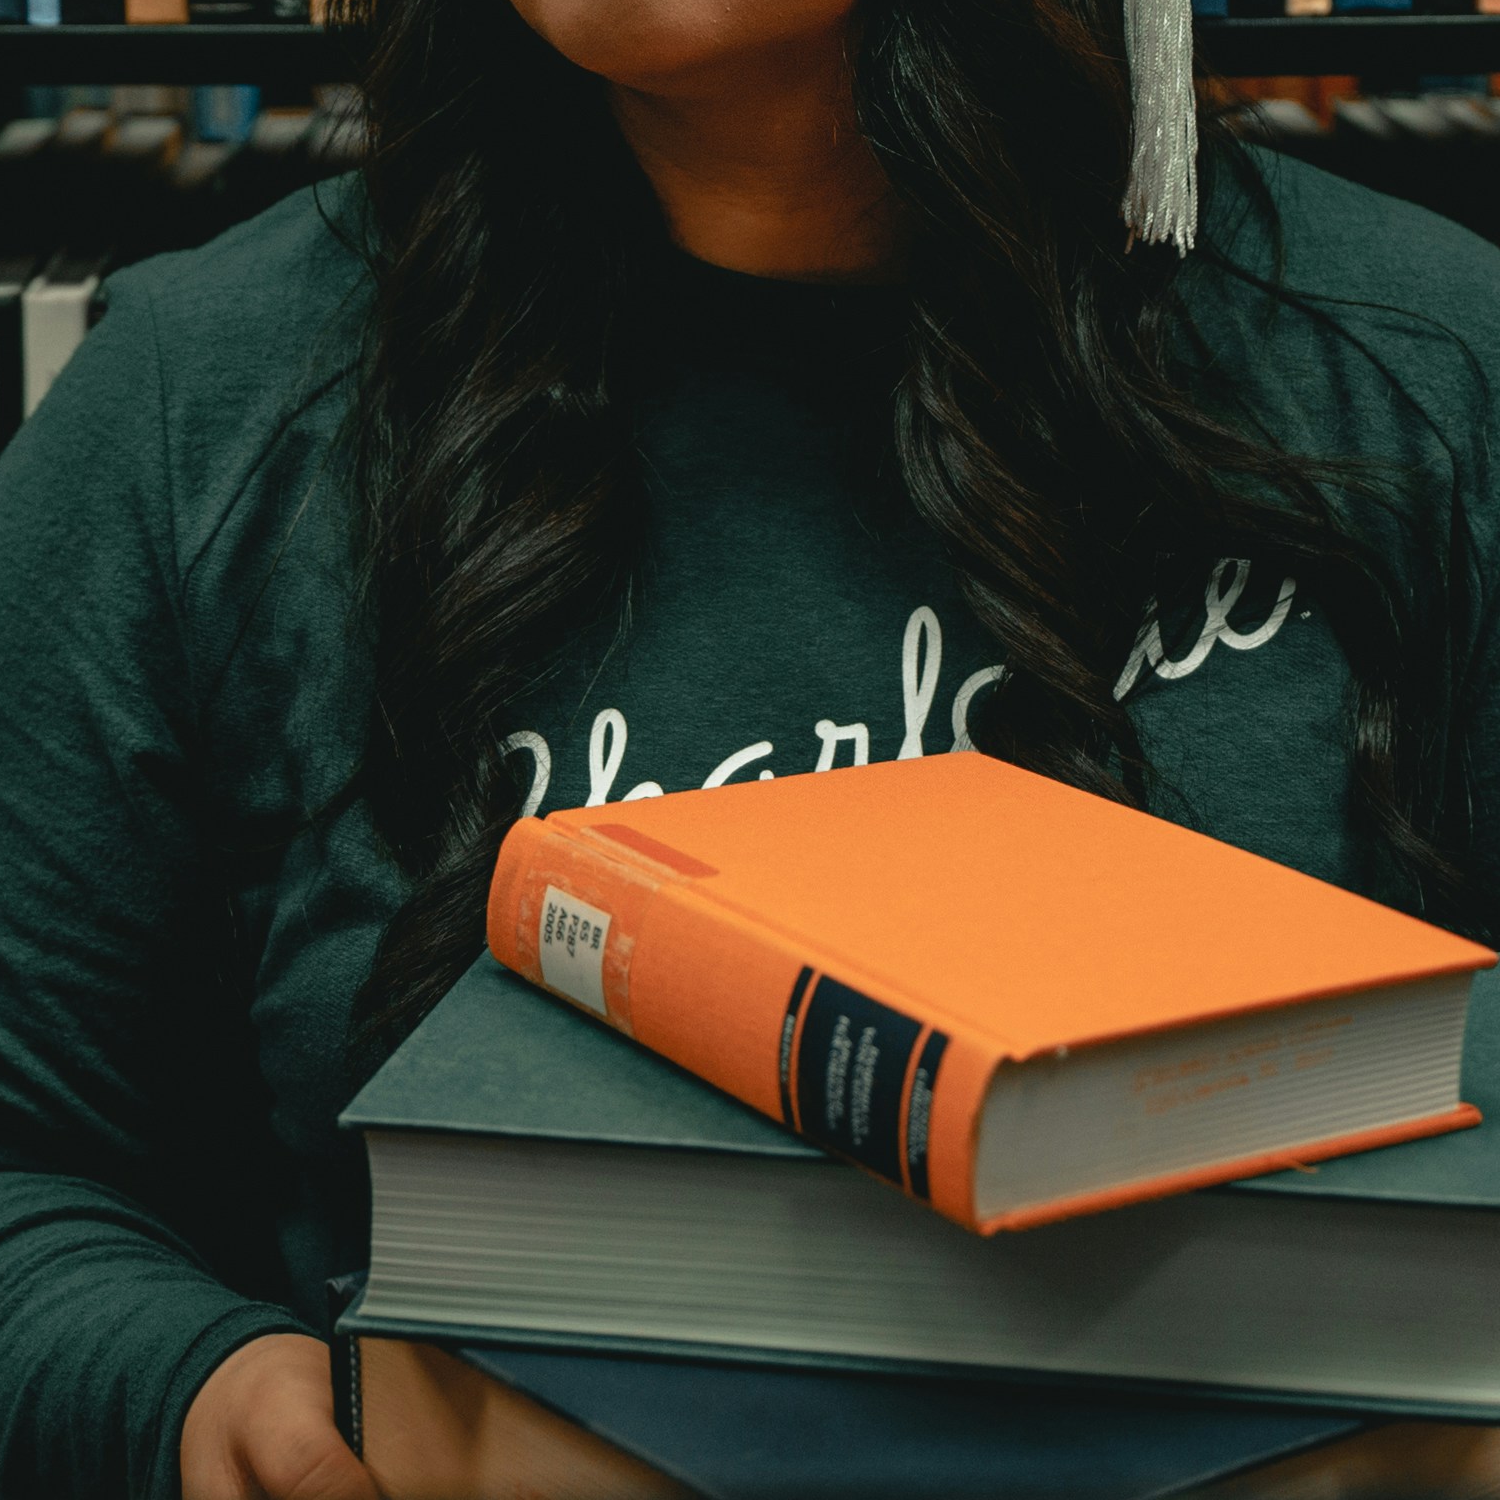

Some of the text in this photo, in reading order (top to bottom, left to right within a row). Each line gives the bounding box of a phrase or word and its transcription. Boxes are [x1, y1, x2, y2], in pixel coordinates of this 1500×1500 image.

[543, 901, 559, 946] 2005
[555, 906, 569, 942] A66
[566, 913, 581, 959] P287
[579, 919, 591, 944] 65
[590, 925, 603, 951] BR
